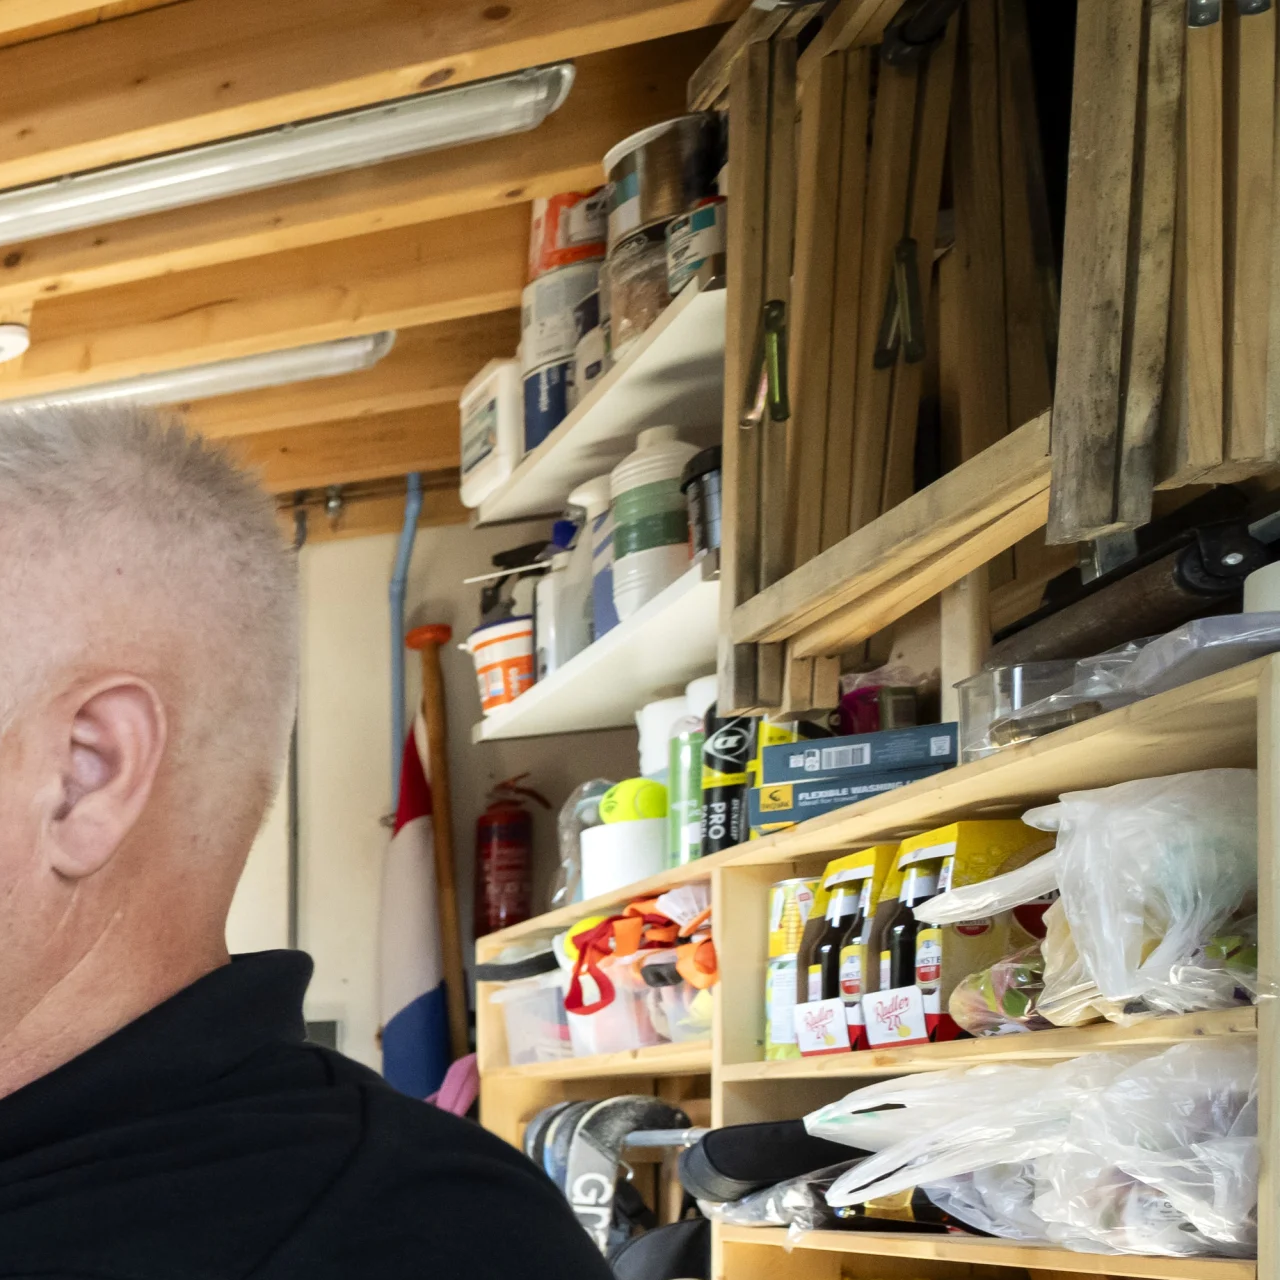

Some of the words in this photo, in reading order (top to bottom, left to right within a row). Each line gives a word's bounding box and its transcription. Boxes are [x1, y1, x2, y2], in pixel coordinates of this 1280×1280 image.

[798, 786, 849, 801] FLEXIBLE
[851, 782, 904, 795] WASHING
[708, 801, 727, 840] PRO
[730, 799, 740, 841] DUNLOP
[804, 1007, 835, 1028] Radler
[874, 995, 910, 1022] Radler
